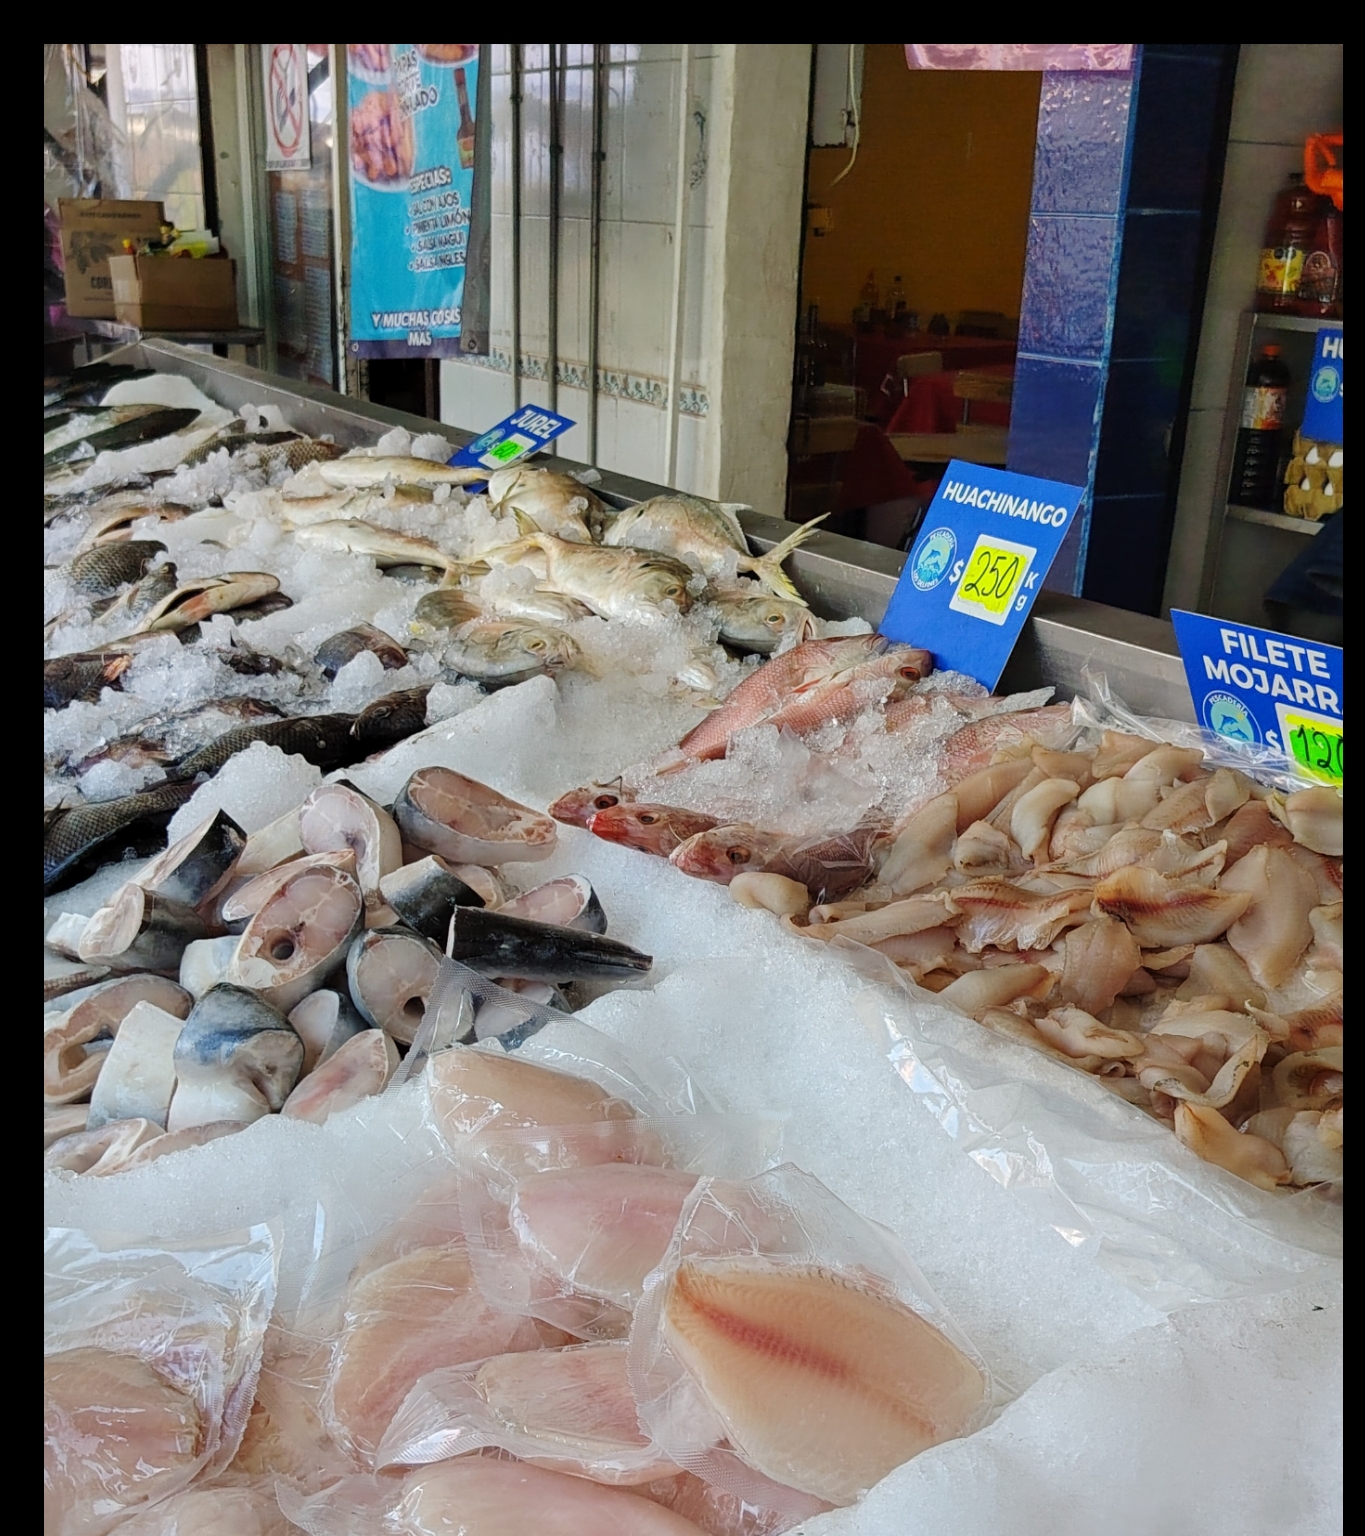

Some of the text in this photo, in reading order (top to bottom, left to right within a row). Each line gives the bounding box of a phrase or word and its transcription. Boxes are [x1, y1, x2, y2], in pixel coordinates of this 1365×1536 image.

[372, 308, 461, 328] Y MUCHAS COSAS
[510, 409, 563, 440] JUREL
[942, 480, 1068, 528] HUACHINANGO
[949, 551, 1039, 600] $ 250 K
[1220, 628, 1331, 680] FILETE
[1202, 655, 1343, 715] MOJARR
